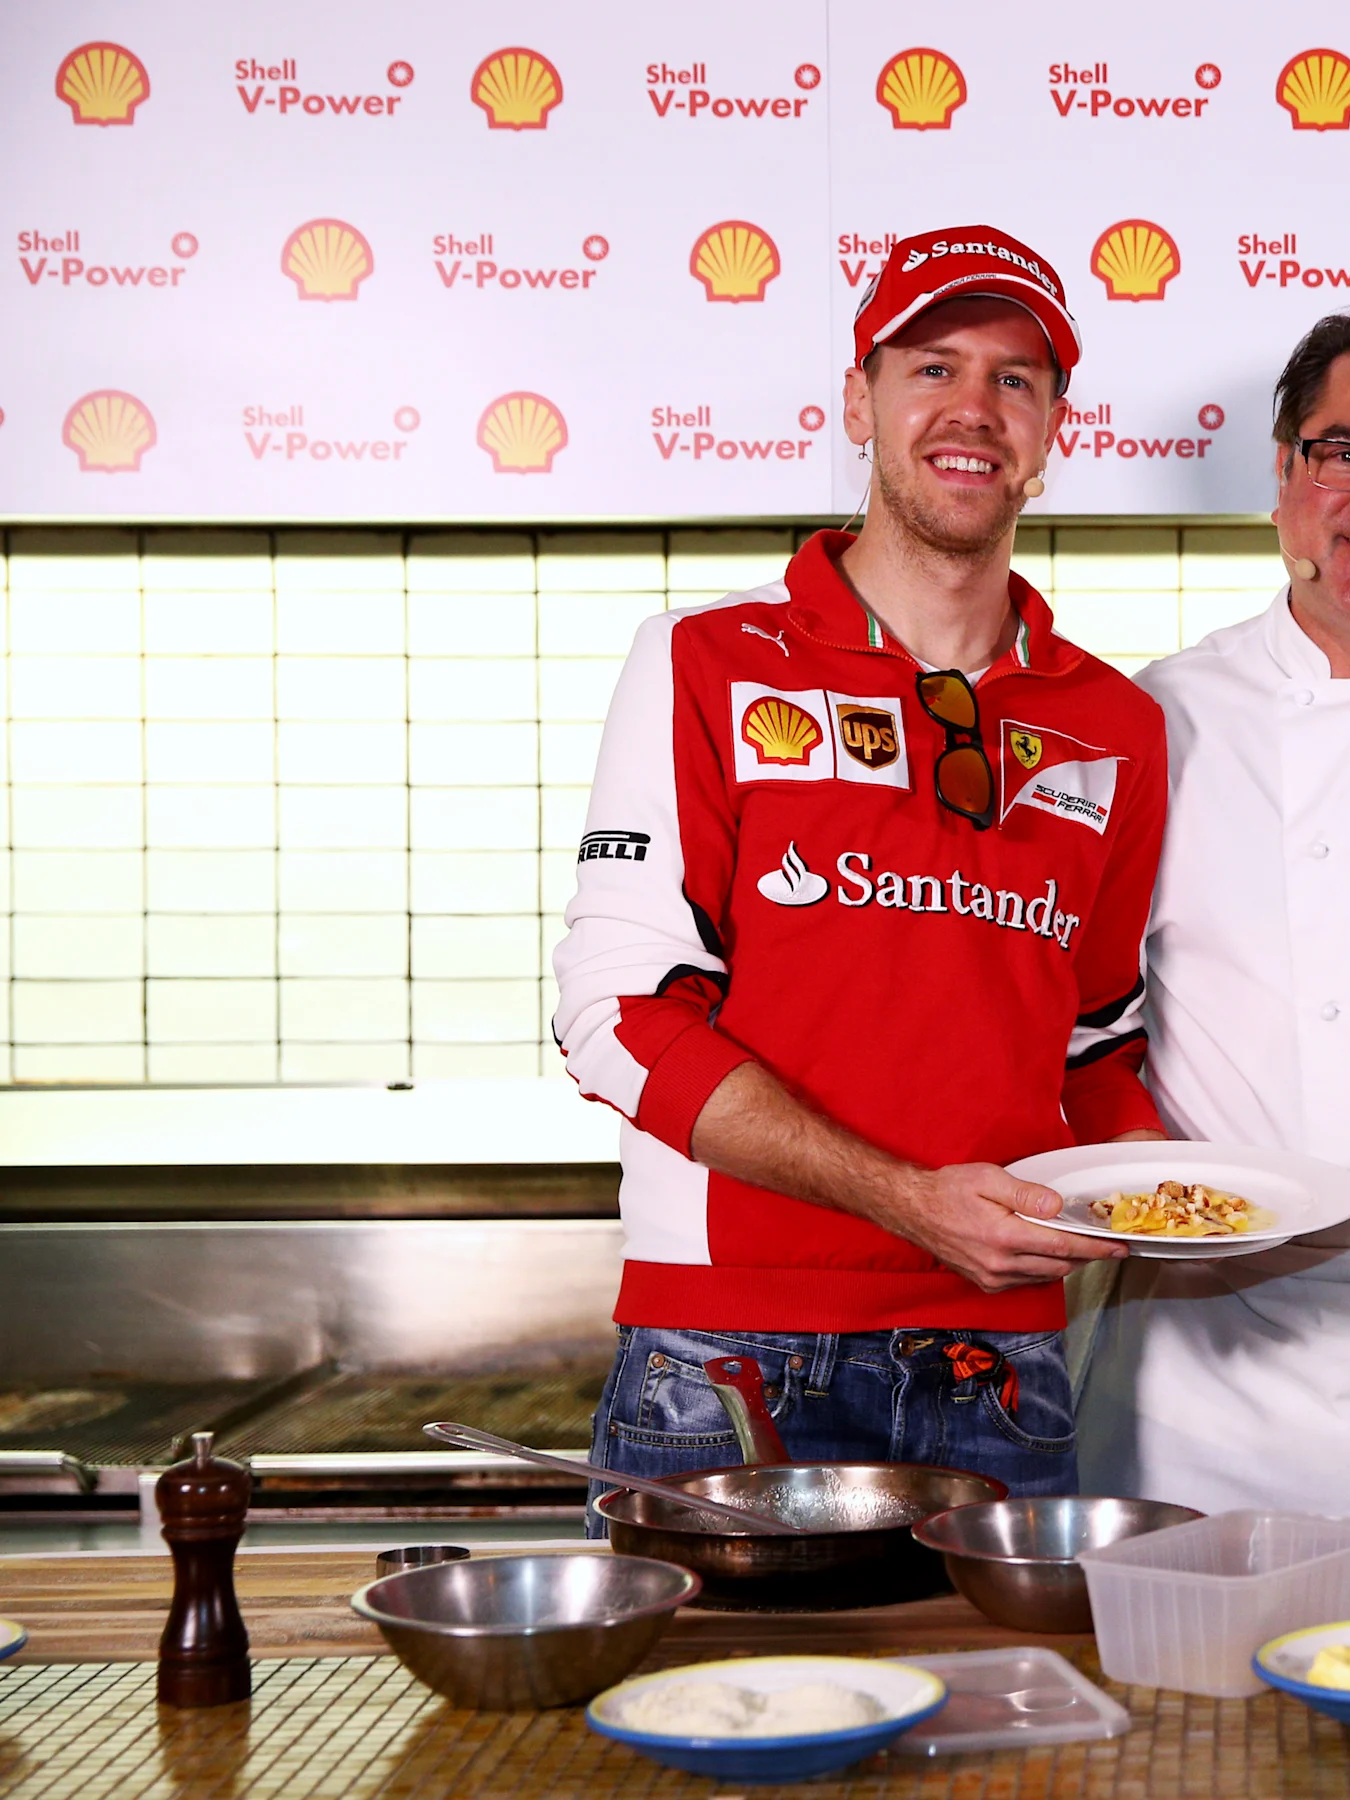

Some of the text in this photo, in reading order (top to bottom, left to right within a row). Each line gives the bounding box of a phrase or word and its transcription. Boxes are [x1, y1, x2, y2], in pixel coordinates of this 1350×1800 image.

[234, 59, 296, 81] Shell
[646, 63, 706, 85] Shell
[1048, 63, 1108, 85] Shell
[236, 85, 401, 116] V-Power
[647, 88, 808, 118] V-Power
[1049, 88, 1209, 118] V-Power
[17, 230, 79, 253] Shell
[433, 234, 493, 255] Shell
[1237, 233, 1297, 255] Shell
[19, 257, 184, 287] V-Power
[435, 260, 597, 289] V-Power
[931, 240, 1059, 297] Santander
[243, 405, 303, 427] Shell
[651, 406, 710, 427] Shell
[1063, 404, 1111, 425] hell
[244, 432, 408, 461] V-Power
[652, 433, 813, 461] V-Power
[1057, 431, 1212, 458] V-Power
[842, 720, 896, 760] ups
[1034, 784, 1098, 810] SCUDERIA
[1056, 800, 1105, 824] FERRARI
[578, 830, 651, 864] RELLI
[836, 851, 1081, 949] Santander
